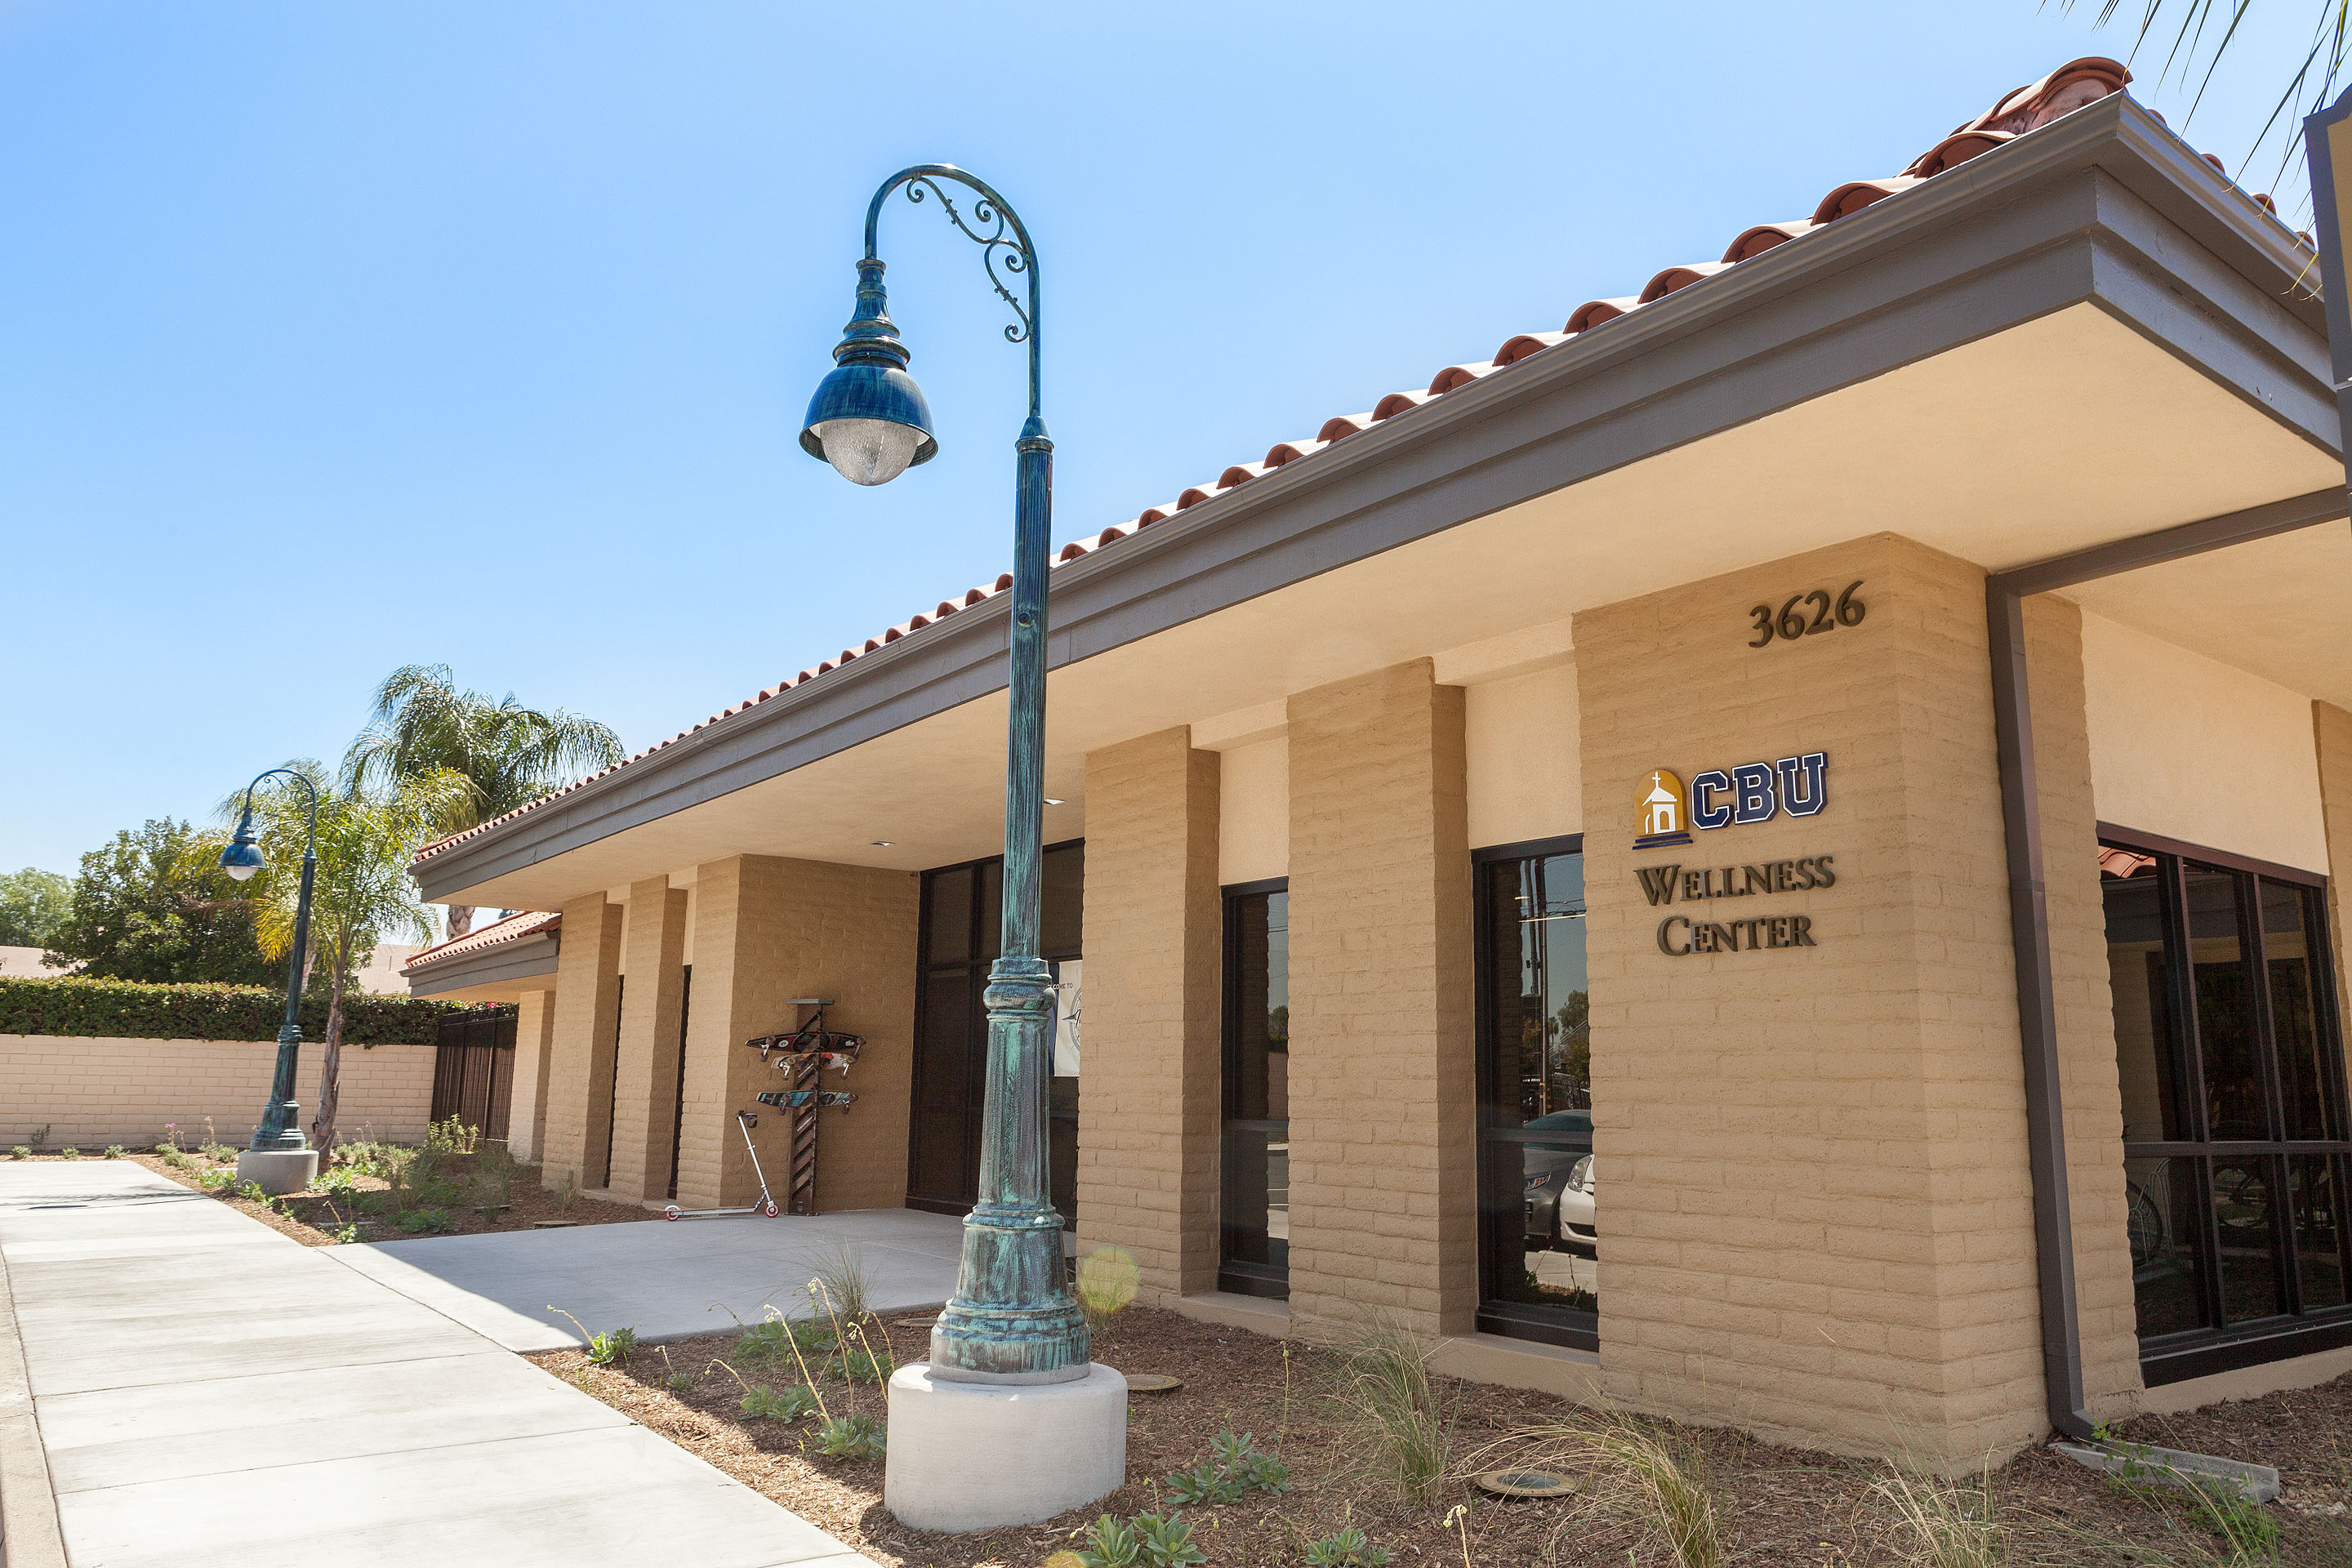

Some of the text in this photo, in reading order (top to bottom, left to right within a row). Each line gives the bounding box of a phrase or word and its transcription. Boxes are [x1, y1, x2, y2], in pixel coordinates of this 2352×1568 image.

[1748, 581, 1866, 648] 3626
[1691, 752, 1829, 830] CBU
[1633, 856, 1837, 906] WELLNESS
[1657, 915, 1817, 956] CENTER
